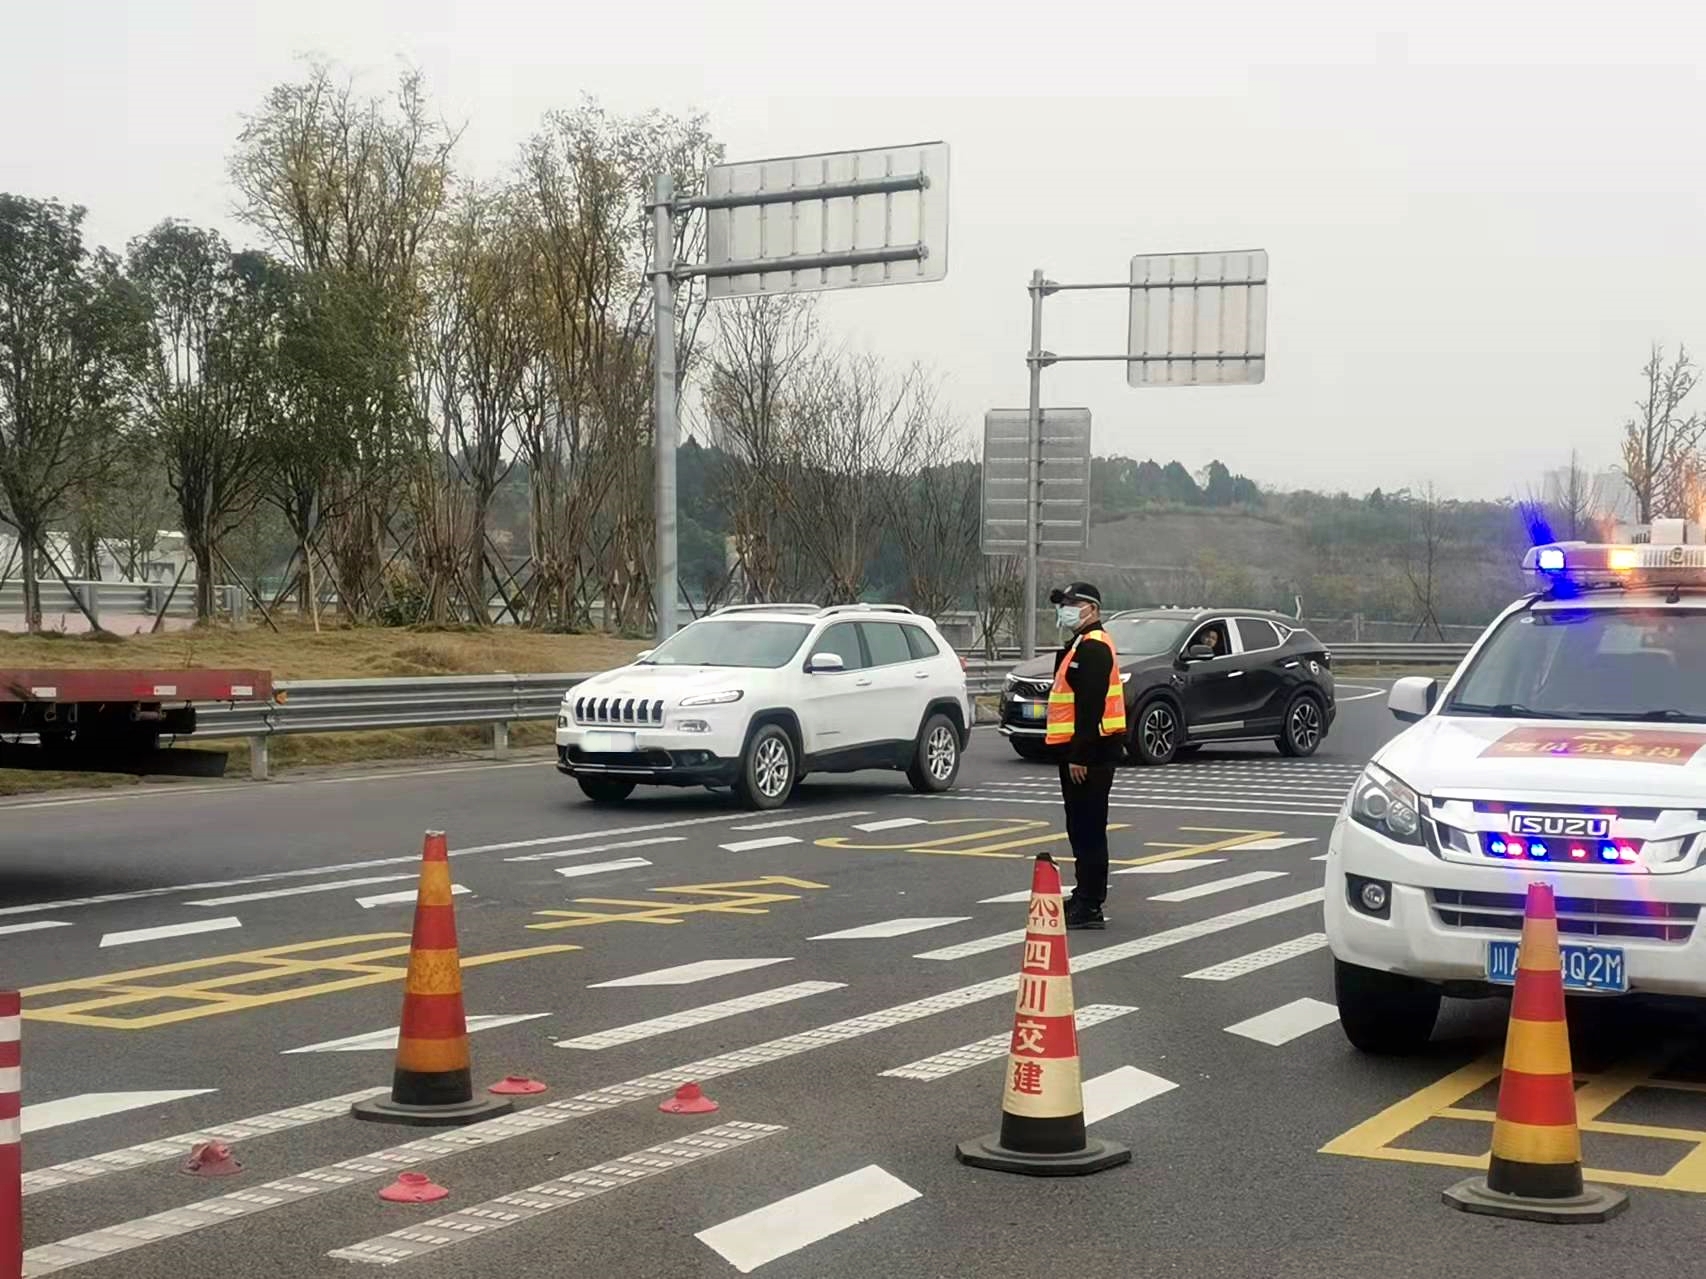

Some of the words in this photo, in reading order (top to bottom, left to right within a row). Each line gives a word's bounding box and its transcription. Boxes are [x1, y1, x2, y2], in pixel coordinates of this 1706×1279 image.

[1513, 816, 1608, 836] ISUZU
[1012, 939, 1052, 1096] 四川交建
